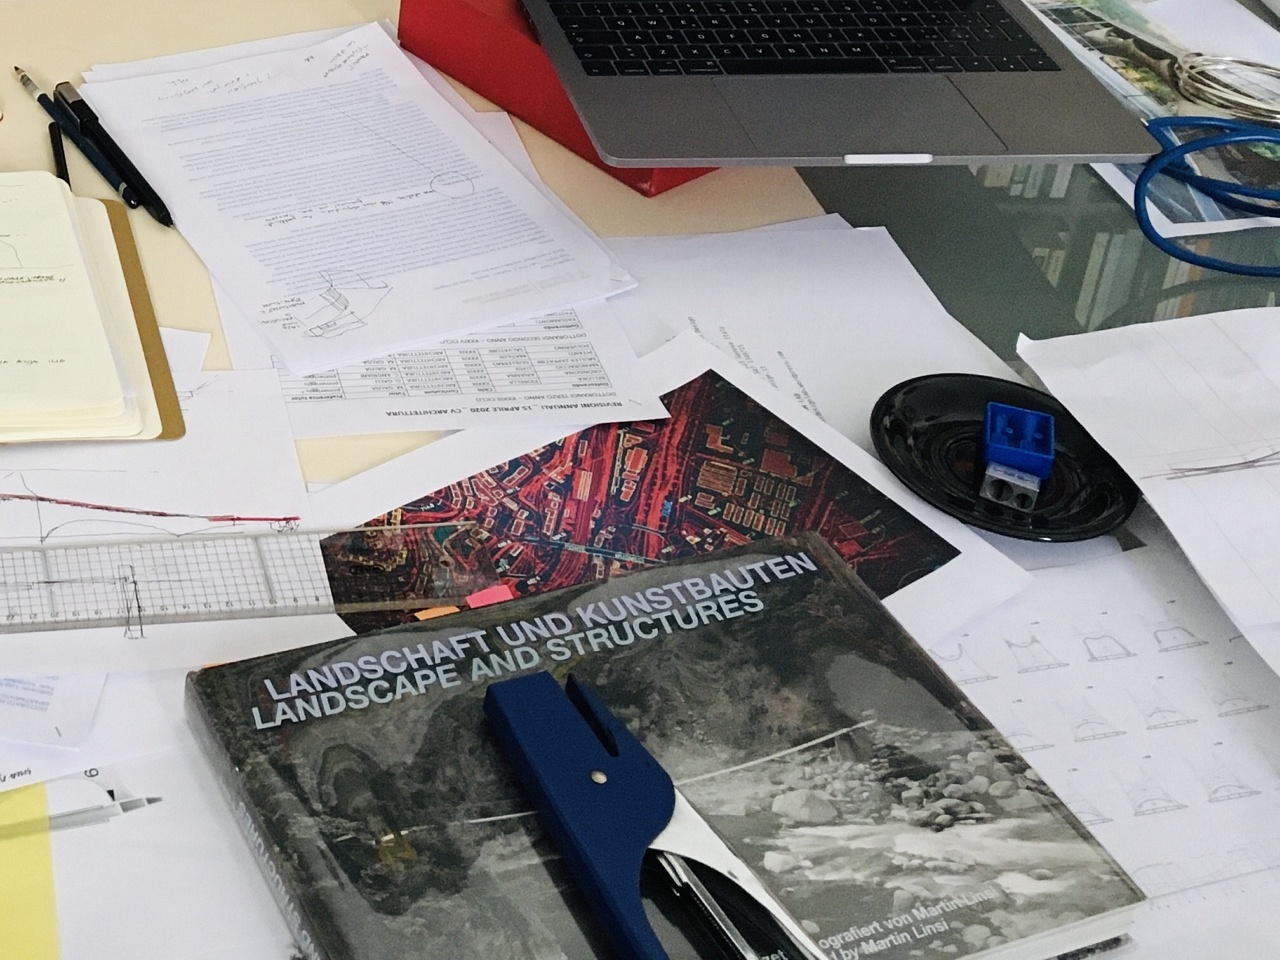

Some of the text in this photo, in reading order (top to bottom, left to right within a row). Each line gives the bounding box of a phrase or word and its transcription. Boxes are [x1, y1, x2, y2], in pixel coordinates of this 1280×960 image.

[250, 588, 765, 731] LANDSCAPE AND STRUCTURES
[263, 550, 819, 702] LANDSCHAFT UND KUNSTBAUTEN
[817, 888, 998, 950] ografiert von Martin Linsi
[860, 917, 951, 956] Martin Linsi
